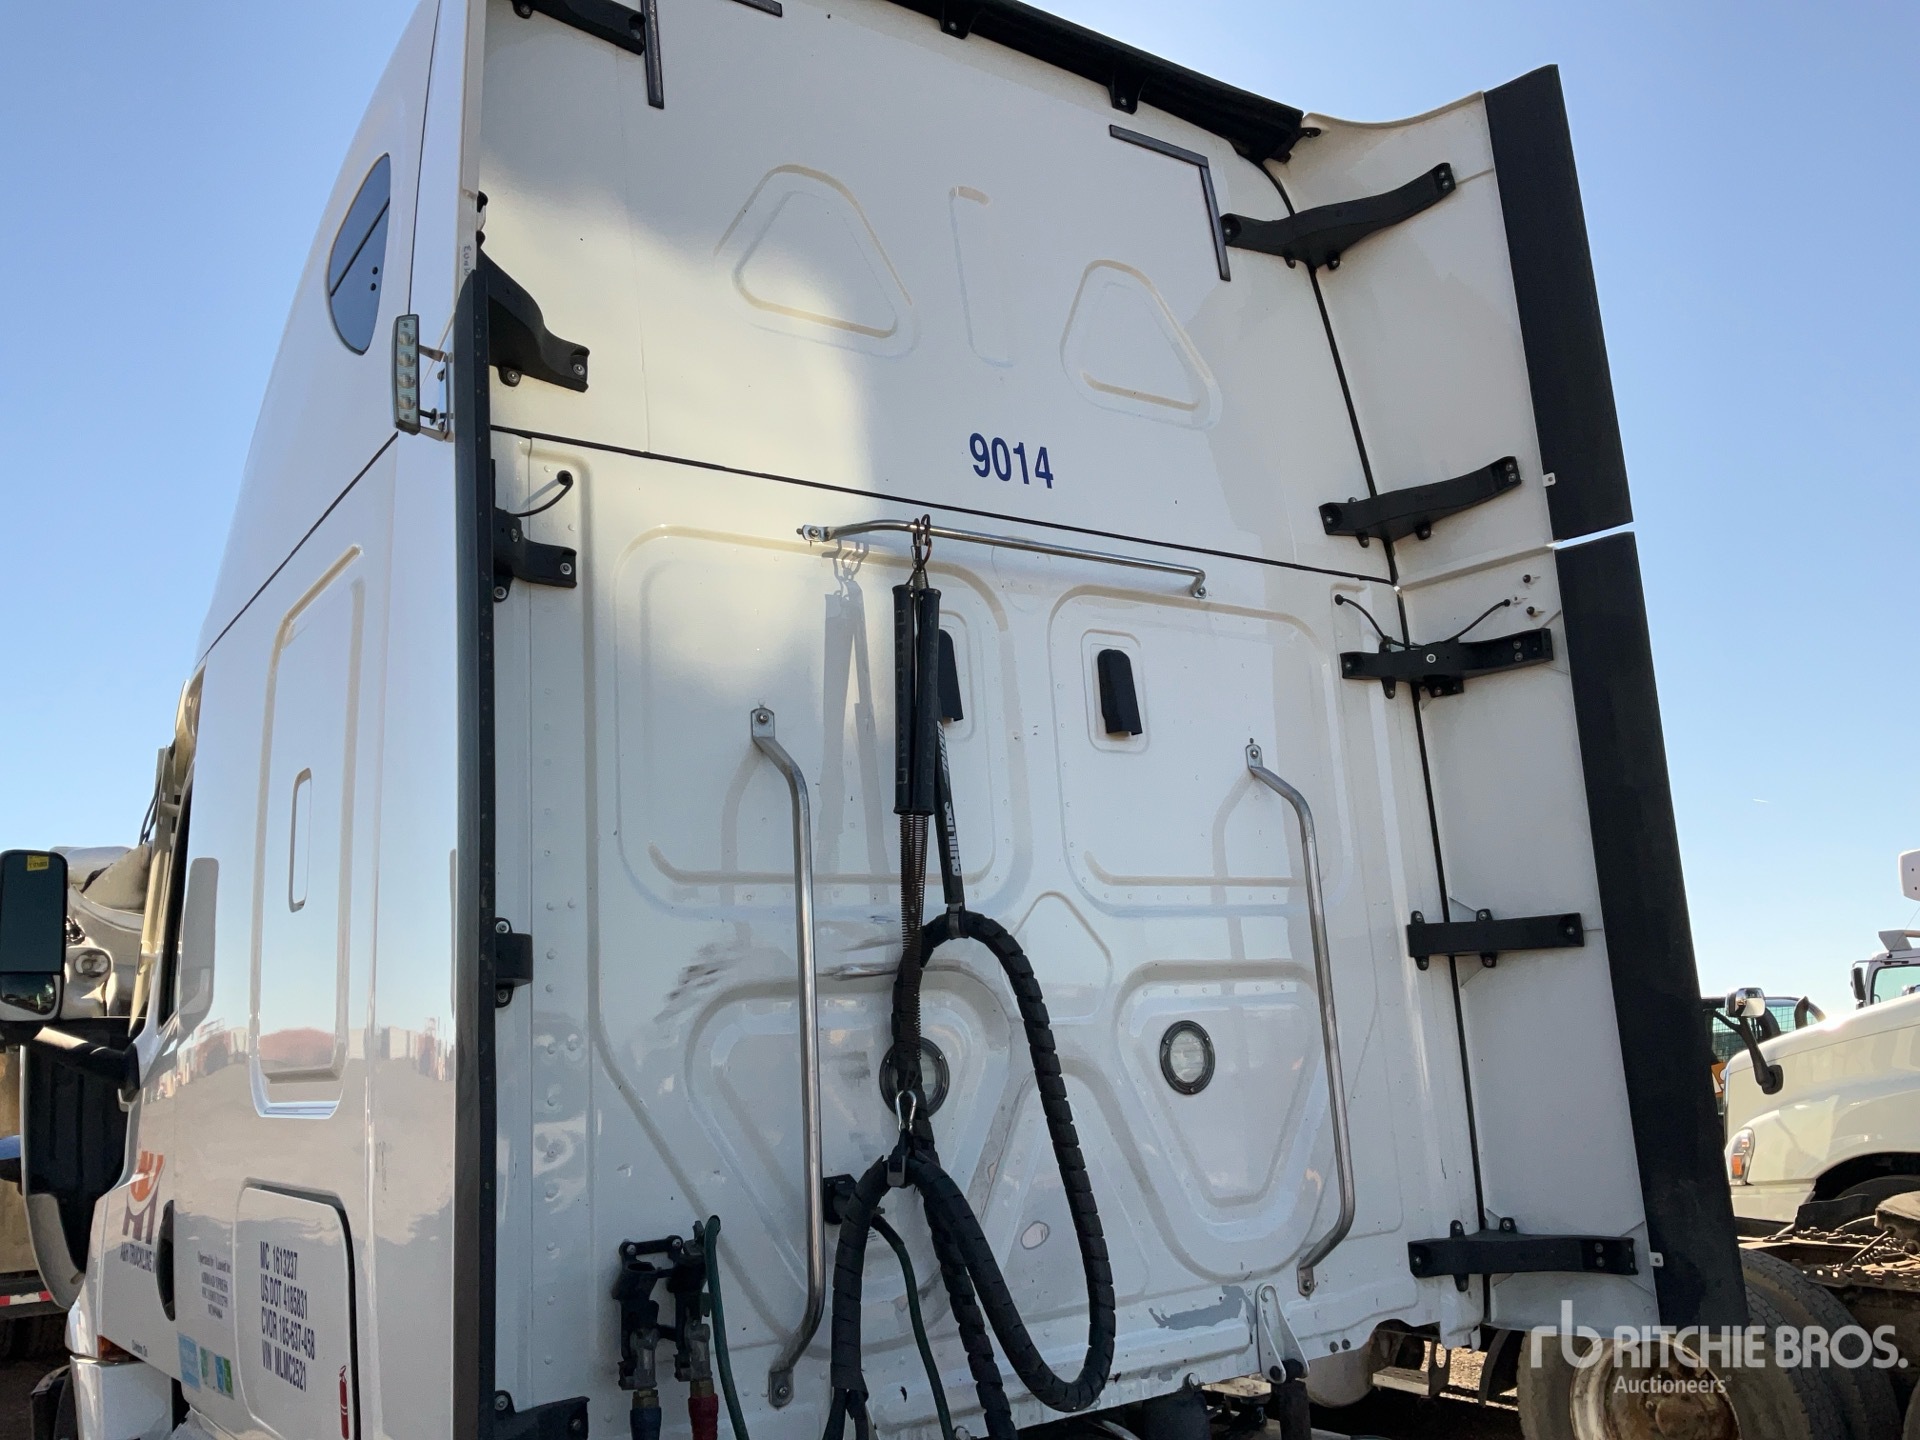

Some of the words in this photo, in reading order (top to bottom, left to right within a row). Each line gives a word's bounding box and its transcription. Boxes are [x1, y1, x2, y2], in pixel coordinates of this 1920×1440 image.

[969, 432, 1054, 489] 9014
[260, 1241, 270, 1270] MC
[273, 1245, 298, 1280] 1613237
[260, 1273, 269, 1303] US
[270, 1277, 282, 1308] DOT
[261, 1306, 278, 1340] CVOR
